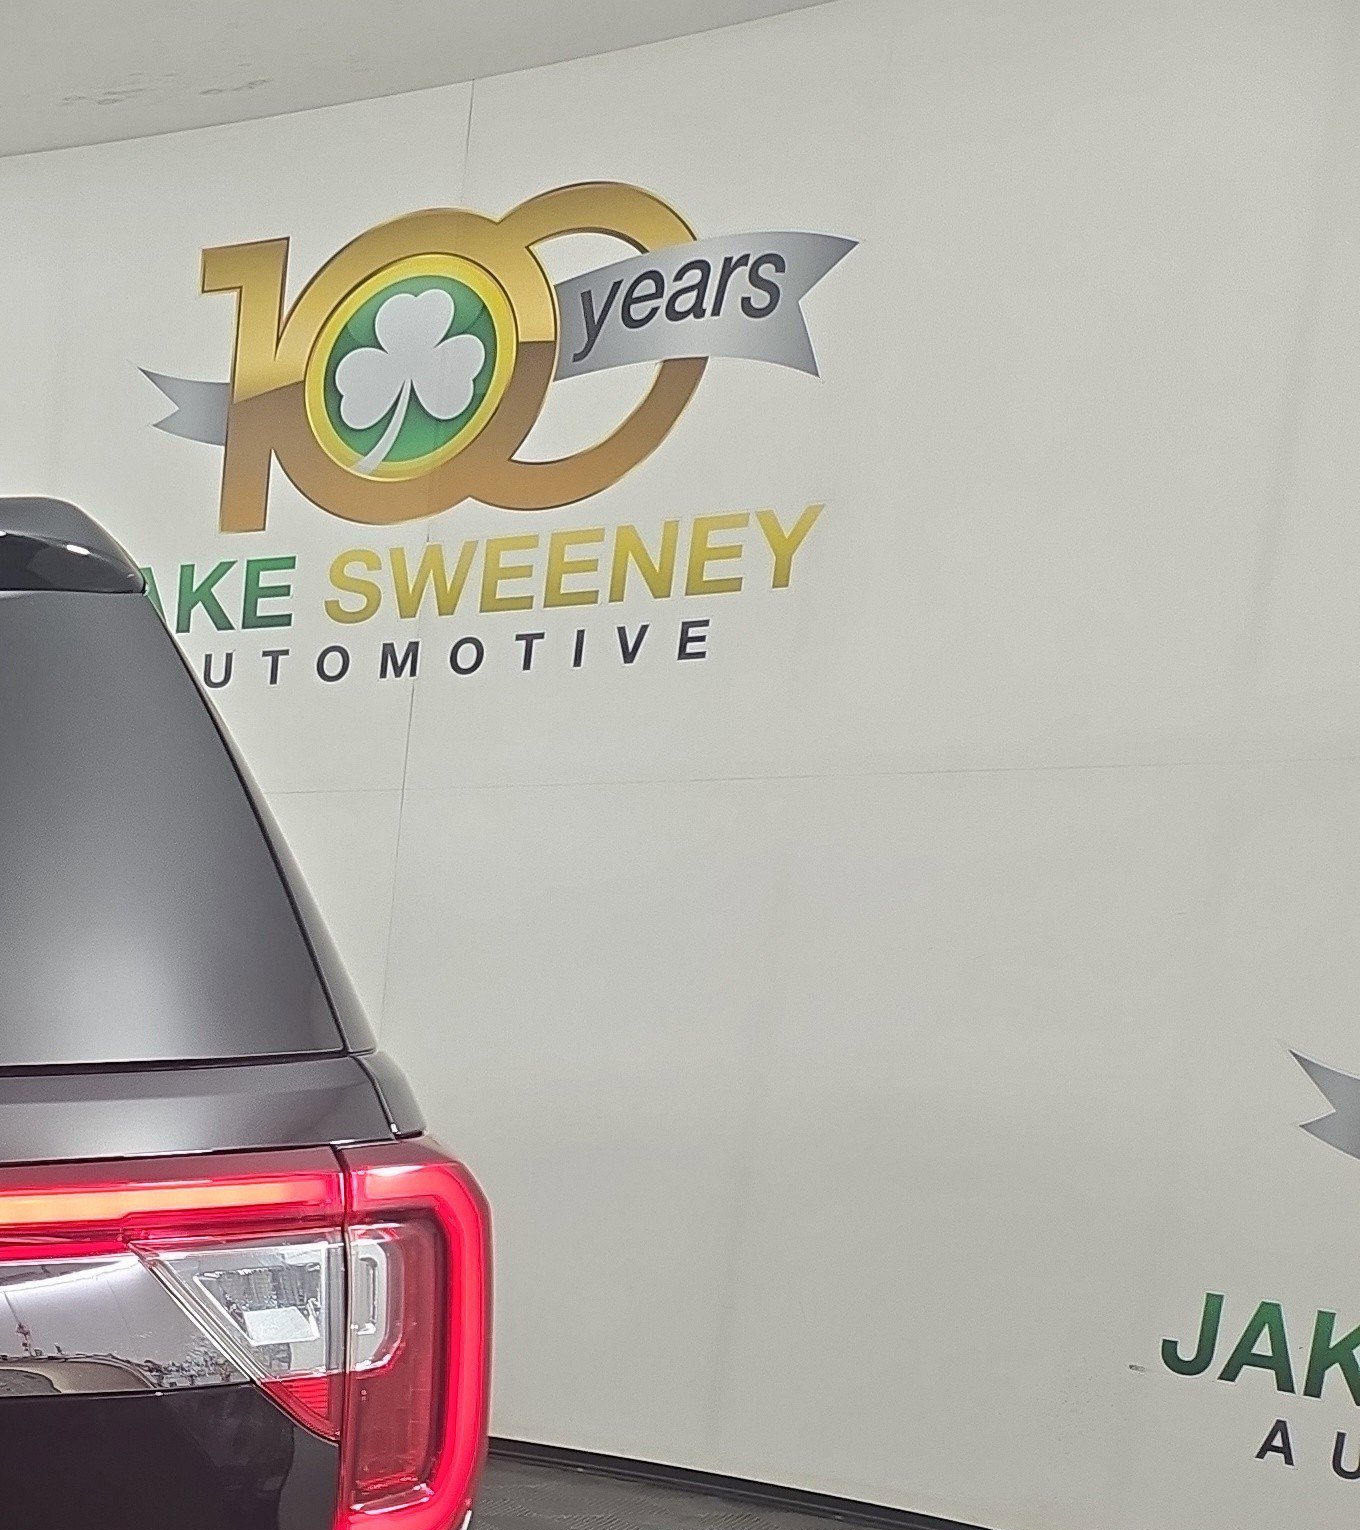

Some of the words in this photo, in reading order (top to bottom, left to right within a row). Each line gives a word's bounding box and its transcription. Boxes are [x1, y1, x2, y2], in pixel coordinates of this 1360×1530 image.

[572, 248, 788, 364] years
[323, 503, 827, 625] SWEENEY
[203, 619, 712, 689] UTOMOTIVE
